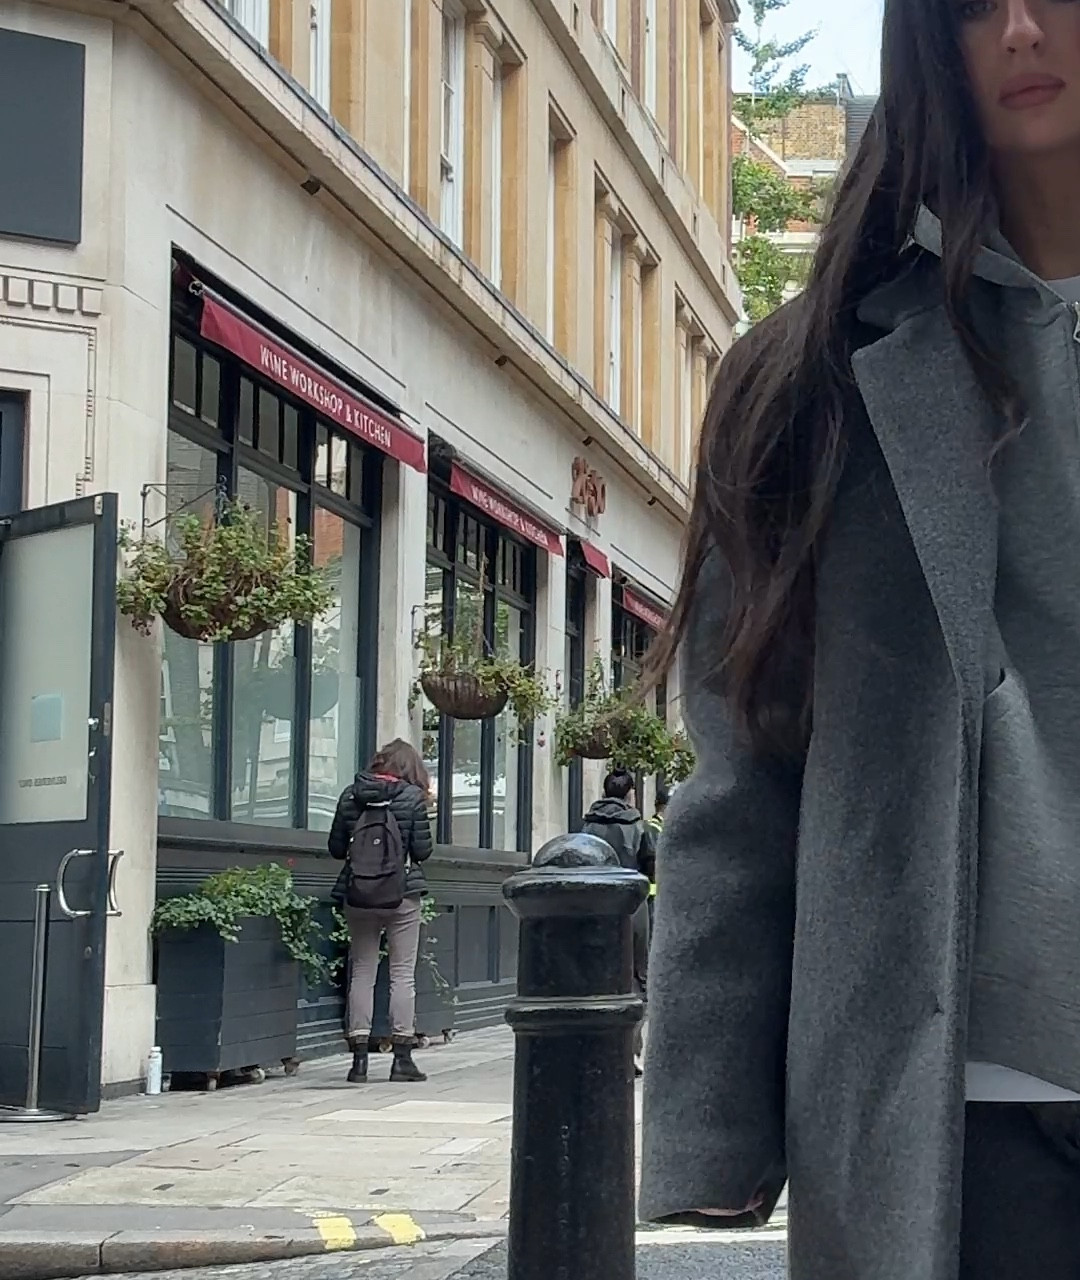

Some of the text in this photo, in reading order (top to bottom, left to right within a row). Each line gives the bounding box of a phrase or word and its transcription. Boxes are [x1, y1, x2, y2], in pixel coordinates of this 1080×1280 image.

[260, 344, 391, 448] WINE WORKSHOP & KITCHEN
